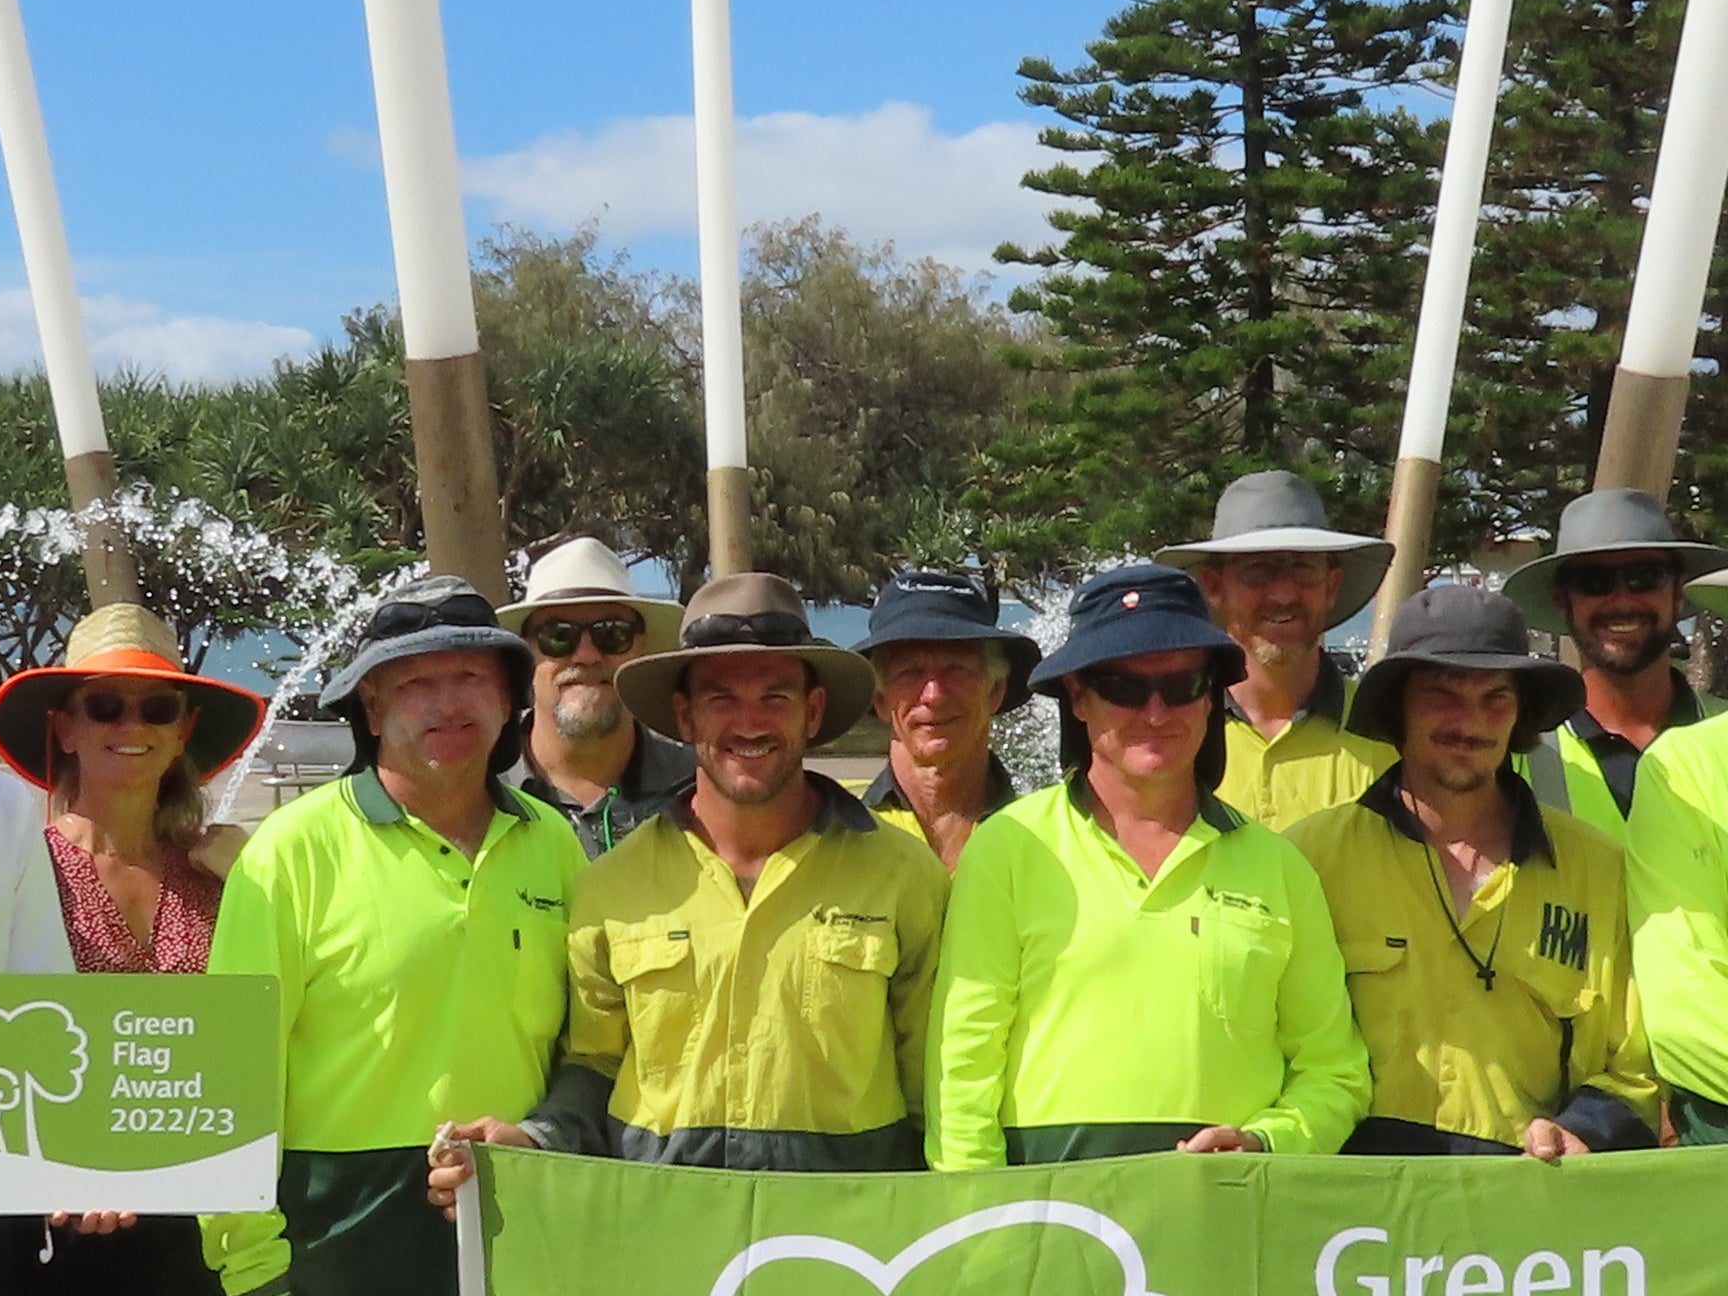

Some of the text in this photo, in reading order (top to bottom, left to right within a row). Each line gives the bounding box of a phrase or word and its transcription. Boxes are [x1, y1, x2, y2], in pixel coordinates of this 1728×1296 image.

[112, 1010, 195, 1036] Green
[112, 1041, 171, 1072] Flag
[110, 1072, 203, 1099] Award
[110, 1107, 235, 1136] 2022/23
